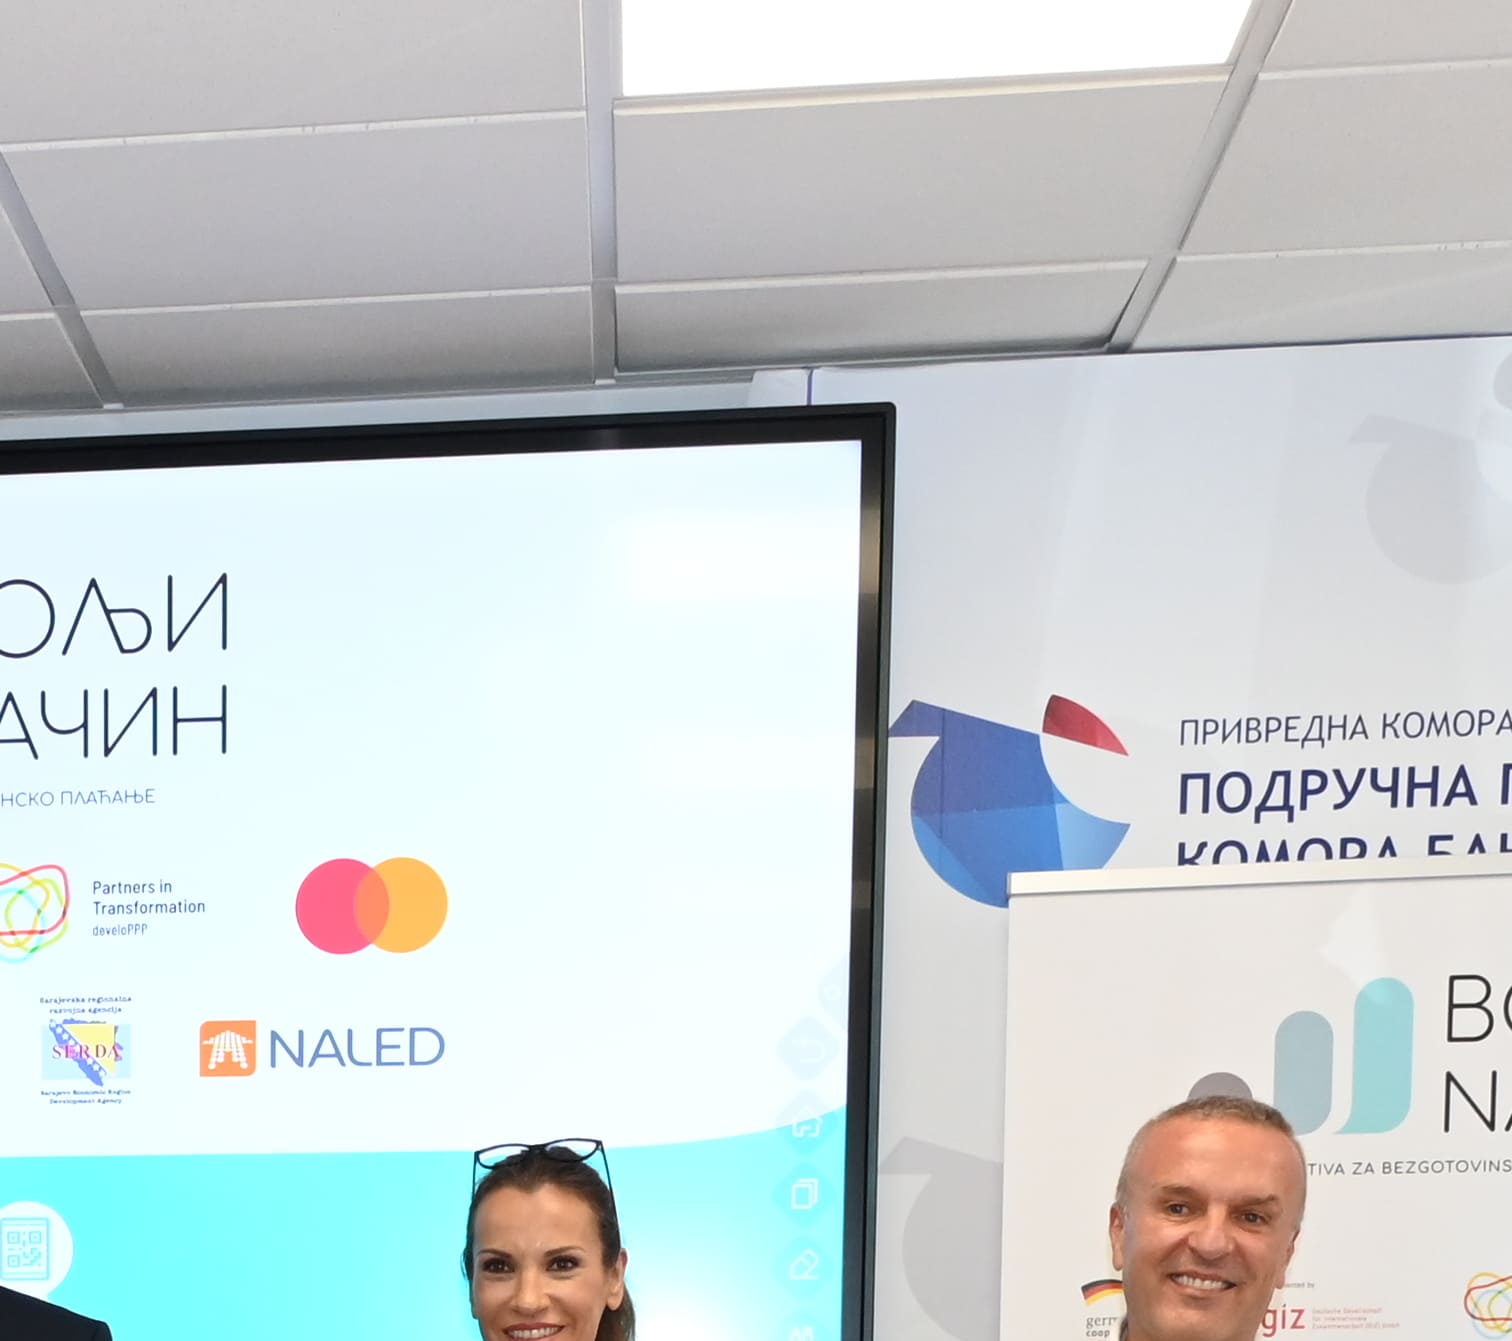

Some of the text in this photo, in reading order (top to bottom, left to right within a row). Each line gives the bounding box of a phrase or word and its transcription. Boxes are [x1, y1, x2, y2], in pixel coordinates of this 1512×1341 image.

[1180, 715, 1369, 748] ПРИВРЕДНА
[60, 788, 155, 806] ПЛАЋАЊЕ
[1179, 764, 1478, 822] ПОДРУЧНА
[93, 880, 172, 894] Partners in
[93, 900, 205, 915] Transformation
[92, 923, 148, 937] develoPPP
[52, 1044, 120, 1060] SERDA
[270, 1027, 446, 1069] NALED
[1352, 1161, 1375, 1176] ZA
[1261, 1303, 1306, 1338] giz
